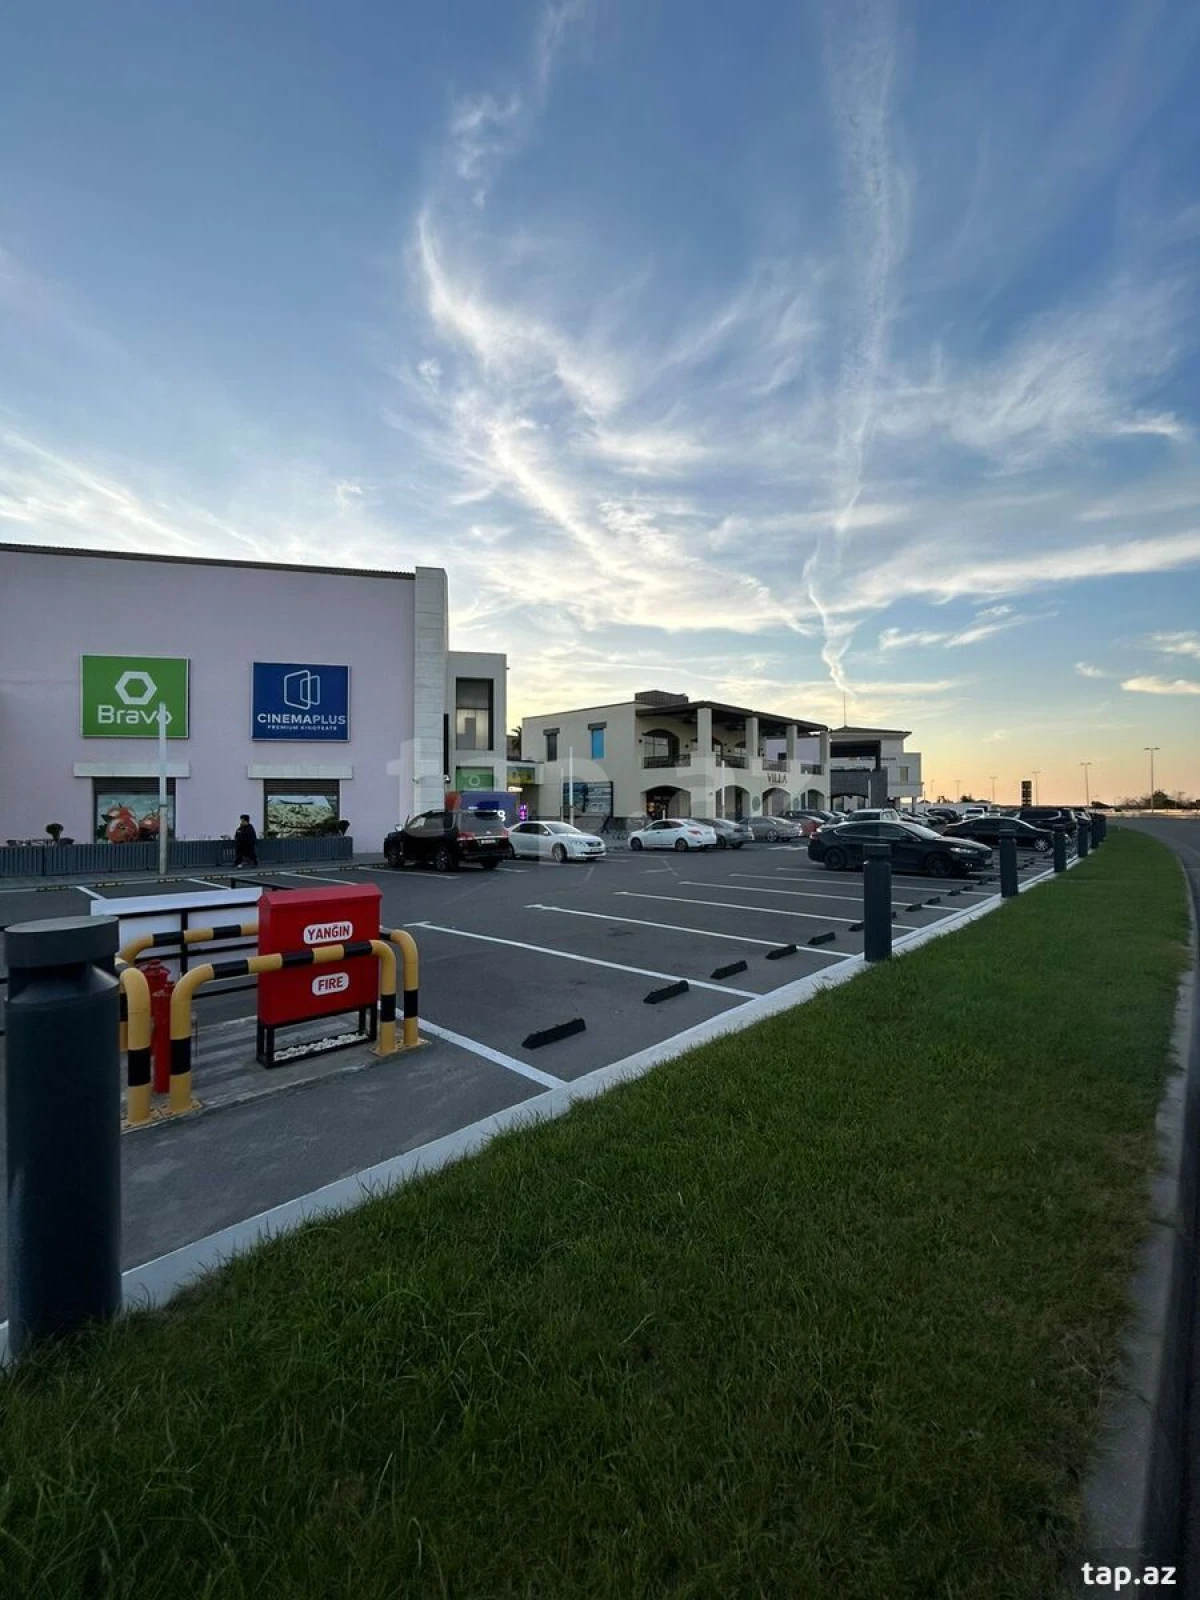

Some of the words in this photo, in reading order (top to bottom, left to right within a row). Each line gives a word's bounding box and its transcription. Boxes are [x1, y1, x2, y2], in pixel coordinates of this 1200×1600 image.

[97, 704, 173, 725] Bravo
[256, 713, 347, 725] CINEMAPLUS
[767, 772, 788, 784] VILLA
[318, 975, 344, 992] FIRE
